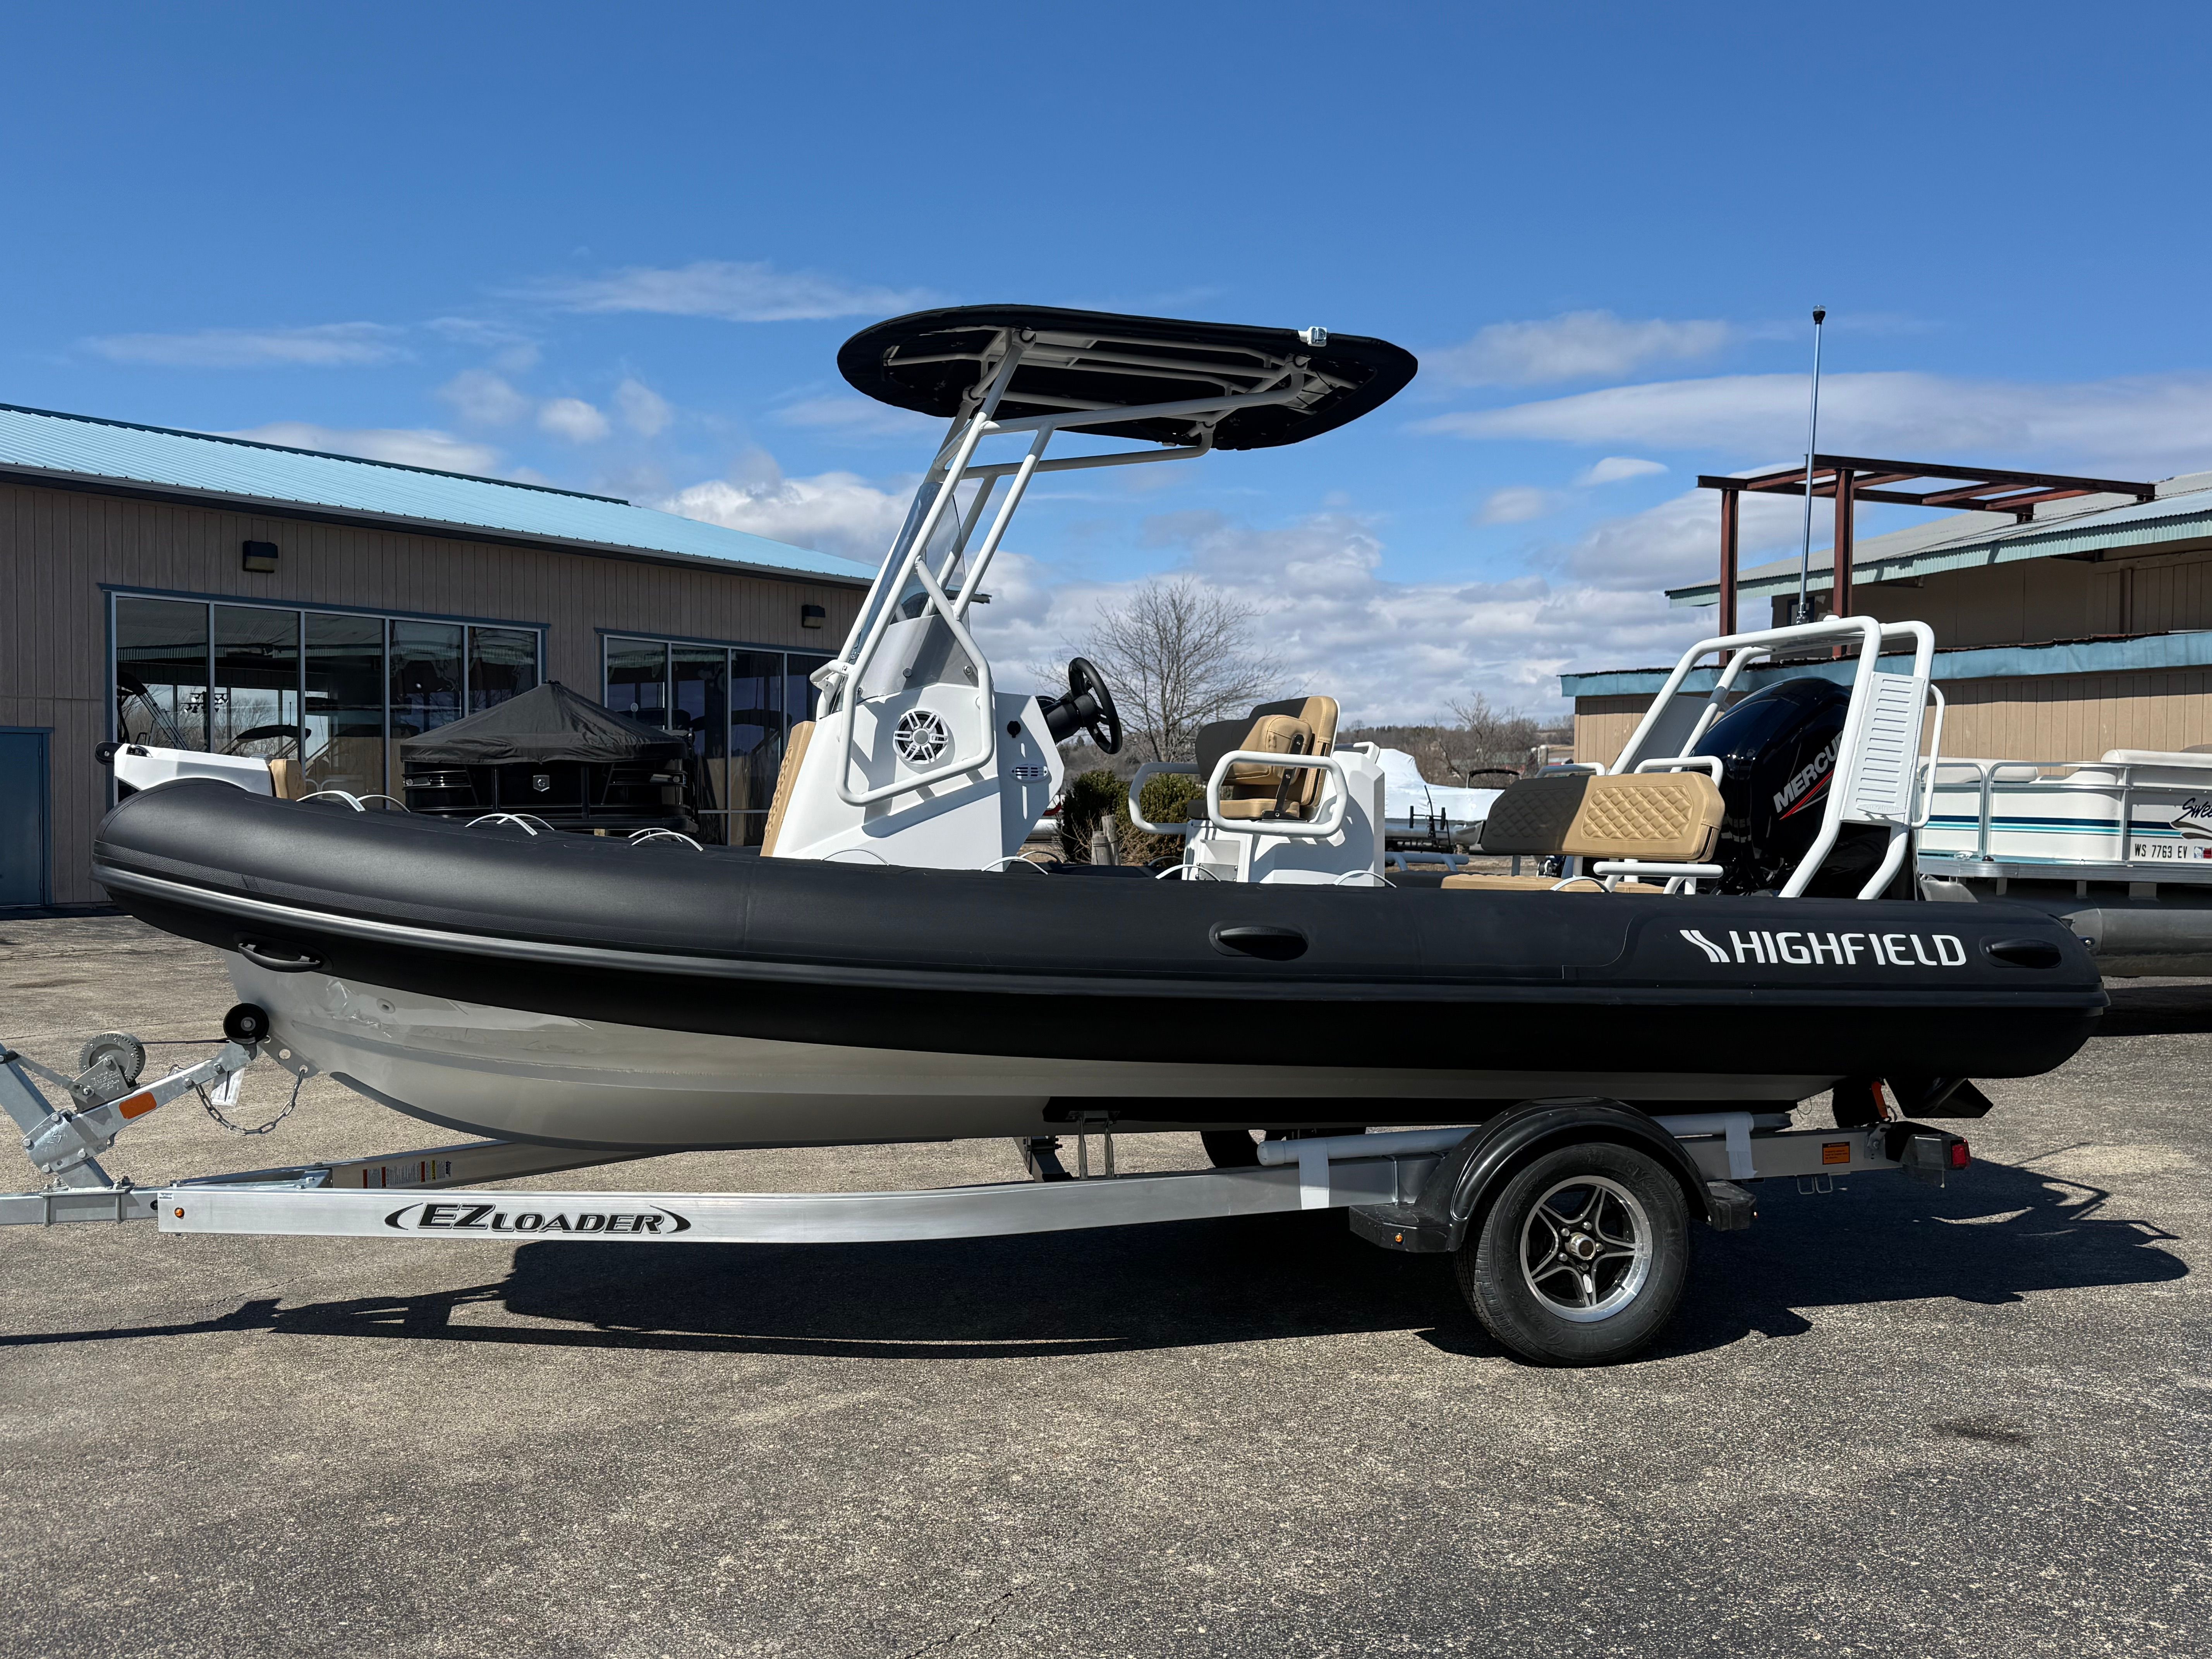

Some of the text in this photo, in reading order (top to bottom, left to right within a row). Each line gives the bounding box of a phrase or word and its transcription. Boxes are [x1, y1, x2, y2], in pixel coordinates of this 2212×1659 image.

[2135, 844, 2187, 859] WS 7763 EV
[1729, 931, 1966, 966] HIGHFIELD
